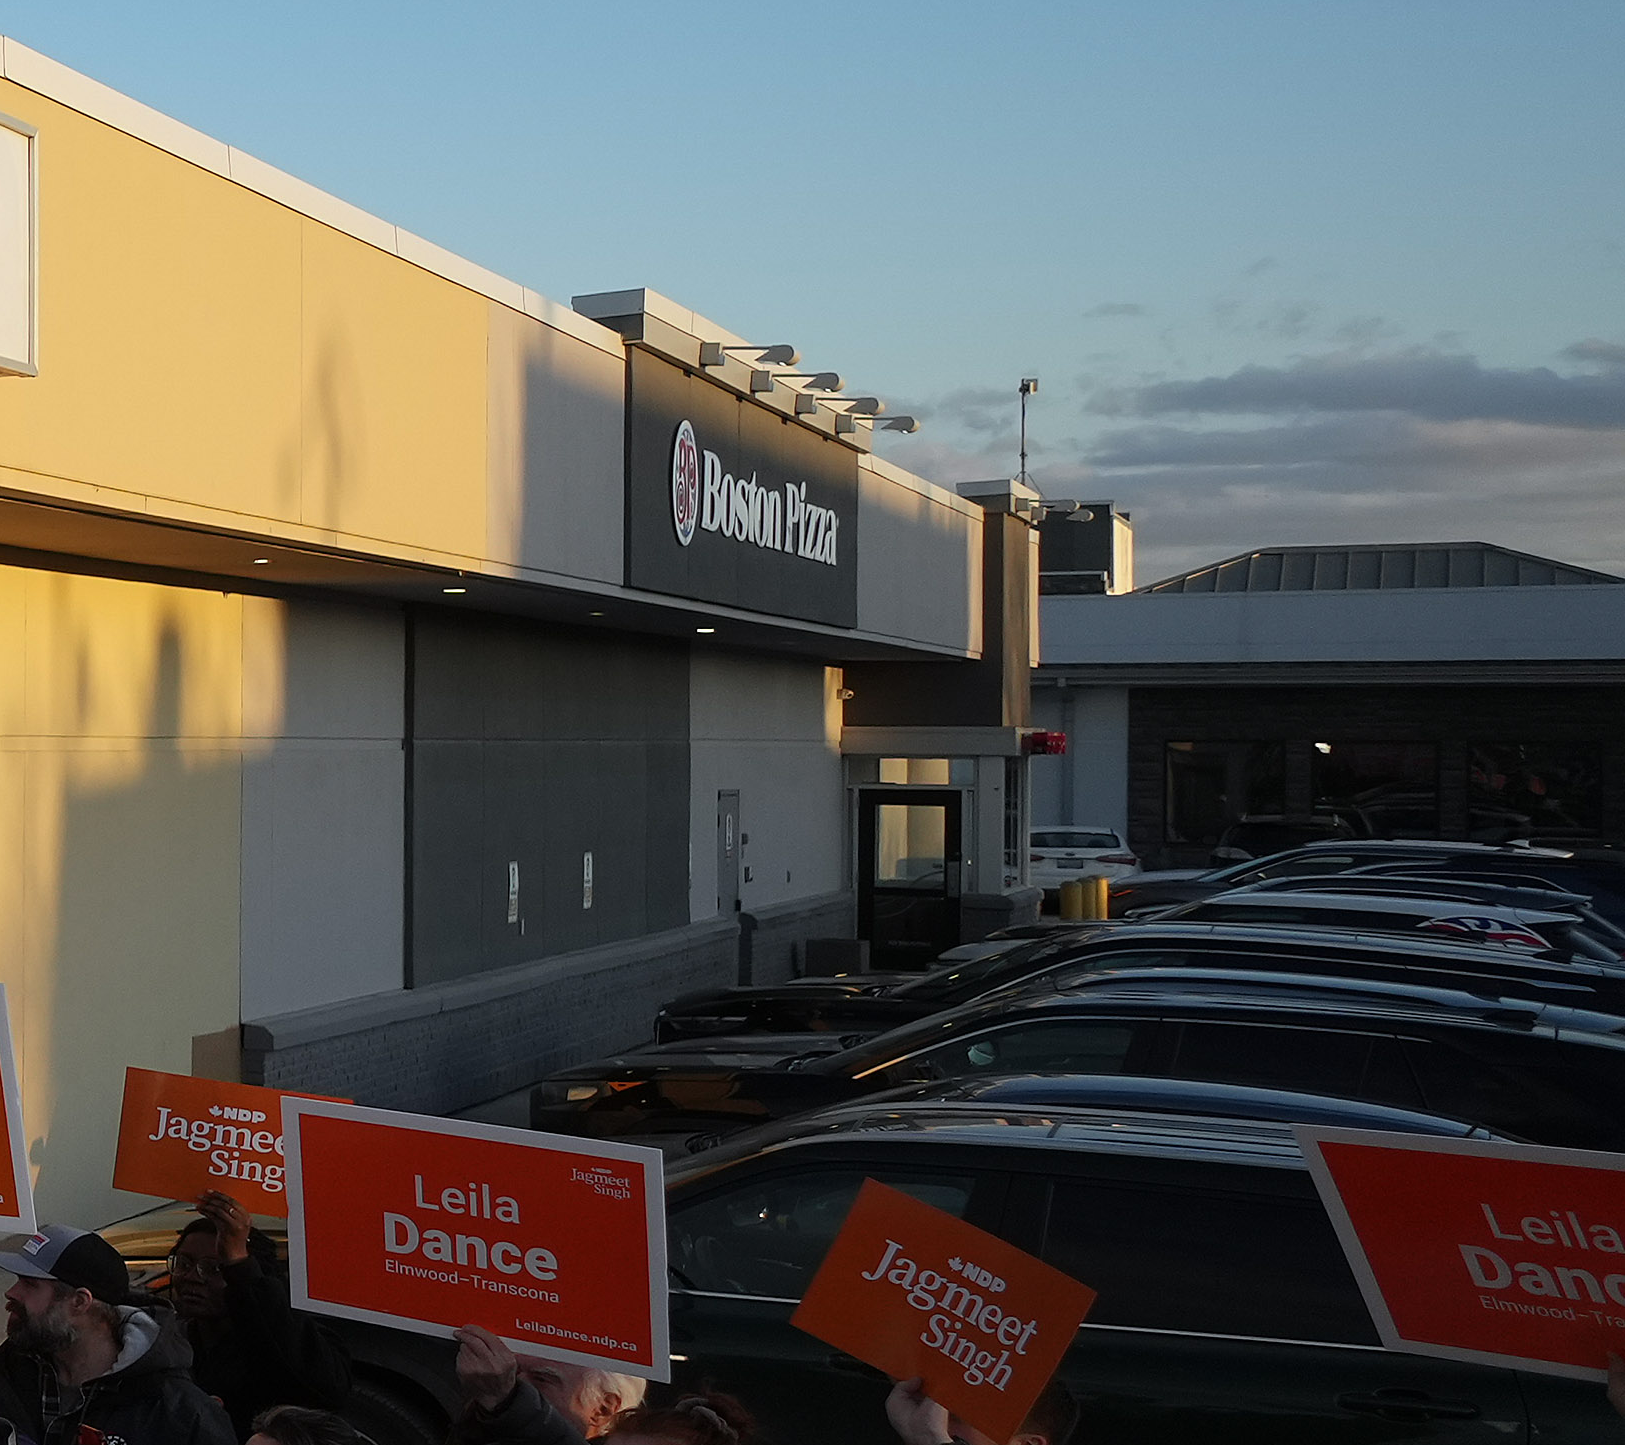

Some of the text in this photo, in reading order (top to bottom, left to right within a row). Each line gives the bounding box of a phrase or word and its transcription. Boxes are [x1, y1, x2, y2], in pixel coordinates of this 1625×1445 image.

[701, 449, 838, 567] Boston Pizza
[149, 1107, 285, 1157] Jagmee
[219, 1106, 267, 1124] NDP
[207, 1150, 286, 1194] Sing
[570, 1167, 631, 1190] Jagmeet
[592, 1182, 632, 1201] Singh
[414, 1174, 521, 1225] Leila
[383, 1211, 558, 1281] Dance
[1480, 1202, 1625, 1255] Leila
[861, 1238, 1038, 1355] Jagmeet
[962, 1261, 1007, 1294] NDP
[515, 1318, 637, 1352] LeilaDance.ndp.ca
[920, 1312, 1014, 1392] Singh
